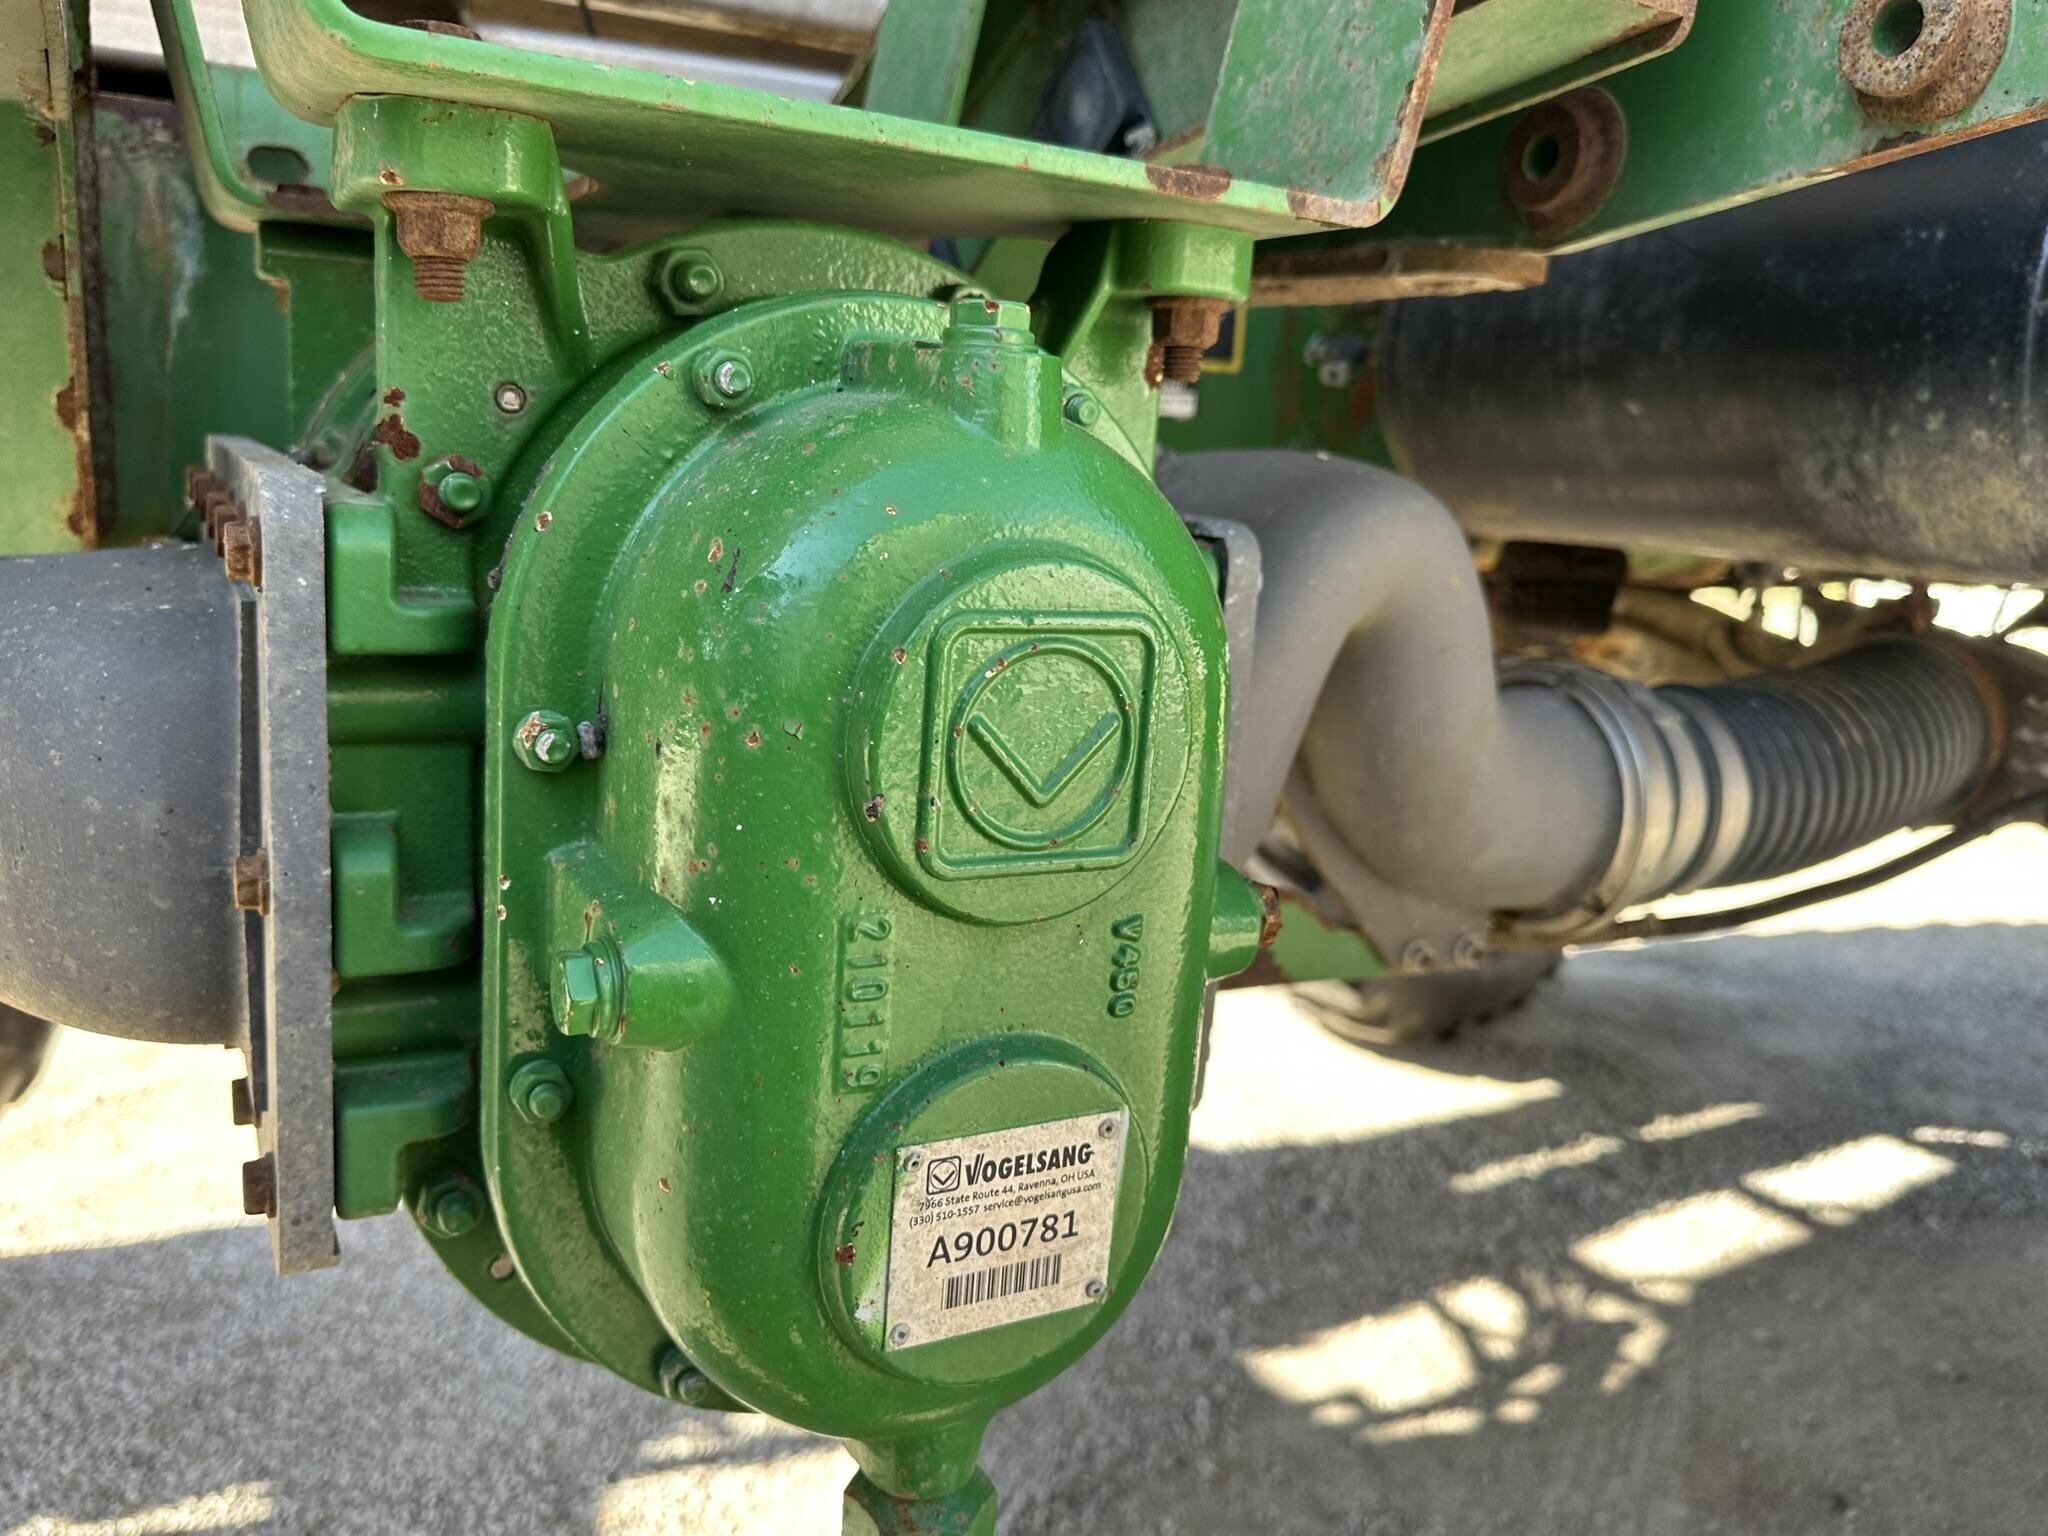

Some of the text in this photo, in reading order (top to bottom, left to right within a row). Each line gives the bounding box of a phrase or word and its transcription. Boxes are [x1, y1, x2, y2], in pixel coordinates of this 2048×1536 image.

[843, 917, 892, 1088] 210119
[945, 1194, 970, 1207] State
[972, 1188, 1000, 1202] Route
[1001, 1184, 1016, 1196] 44,
[1018, 1178, 1059, 1192] Ravenna,
[1061, 1173, 1075, 1184] OH
[1077, 1169, 1095, 1180] USA
[965, 1143, 1095, 1186] VOGELSANG
[909, 1182, 1102, 1229] (330) 510-1557 service@vogelsangusa.com
[926, 1210, 1079, 1268] A900781
